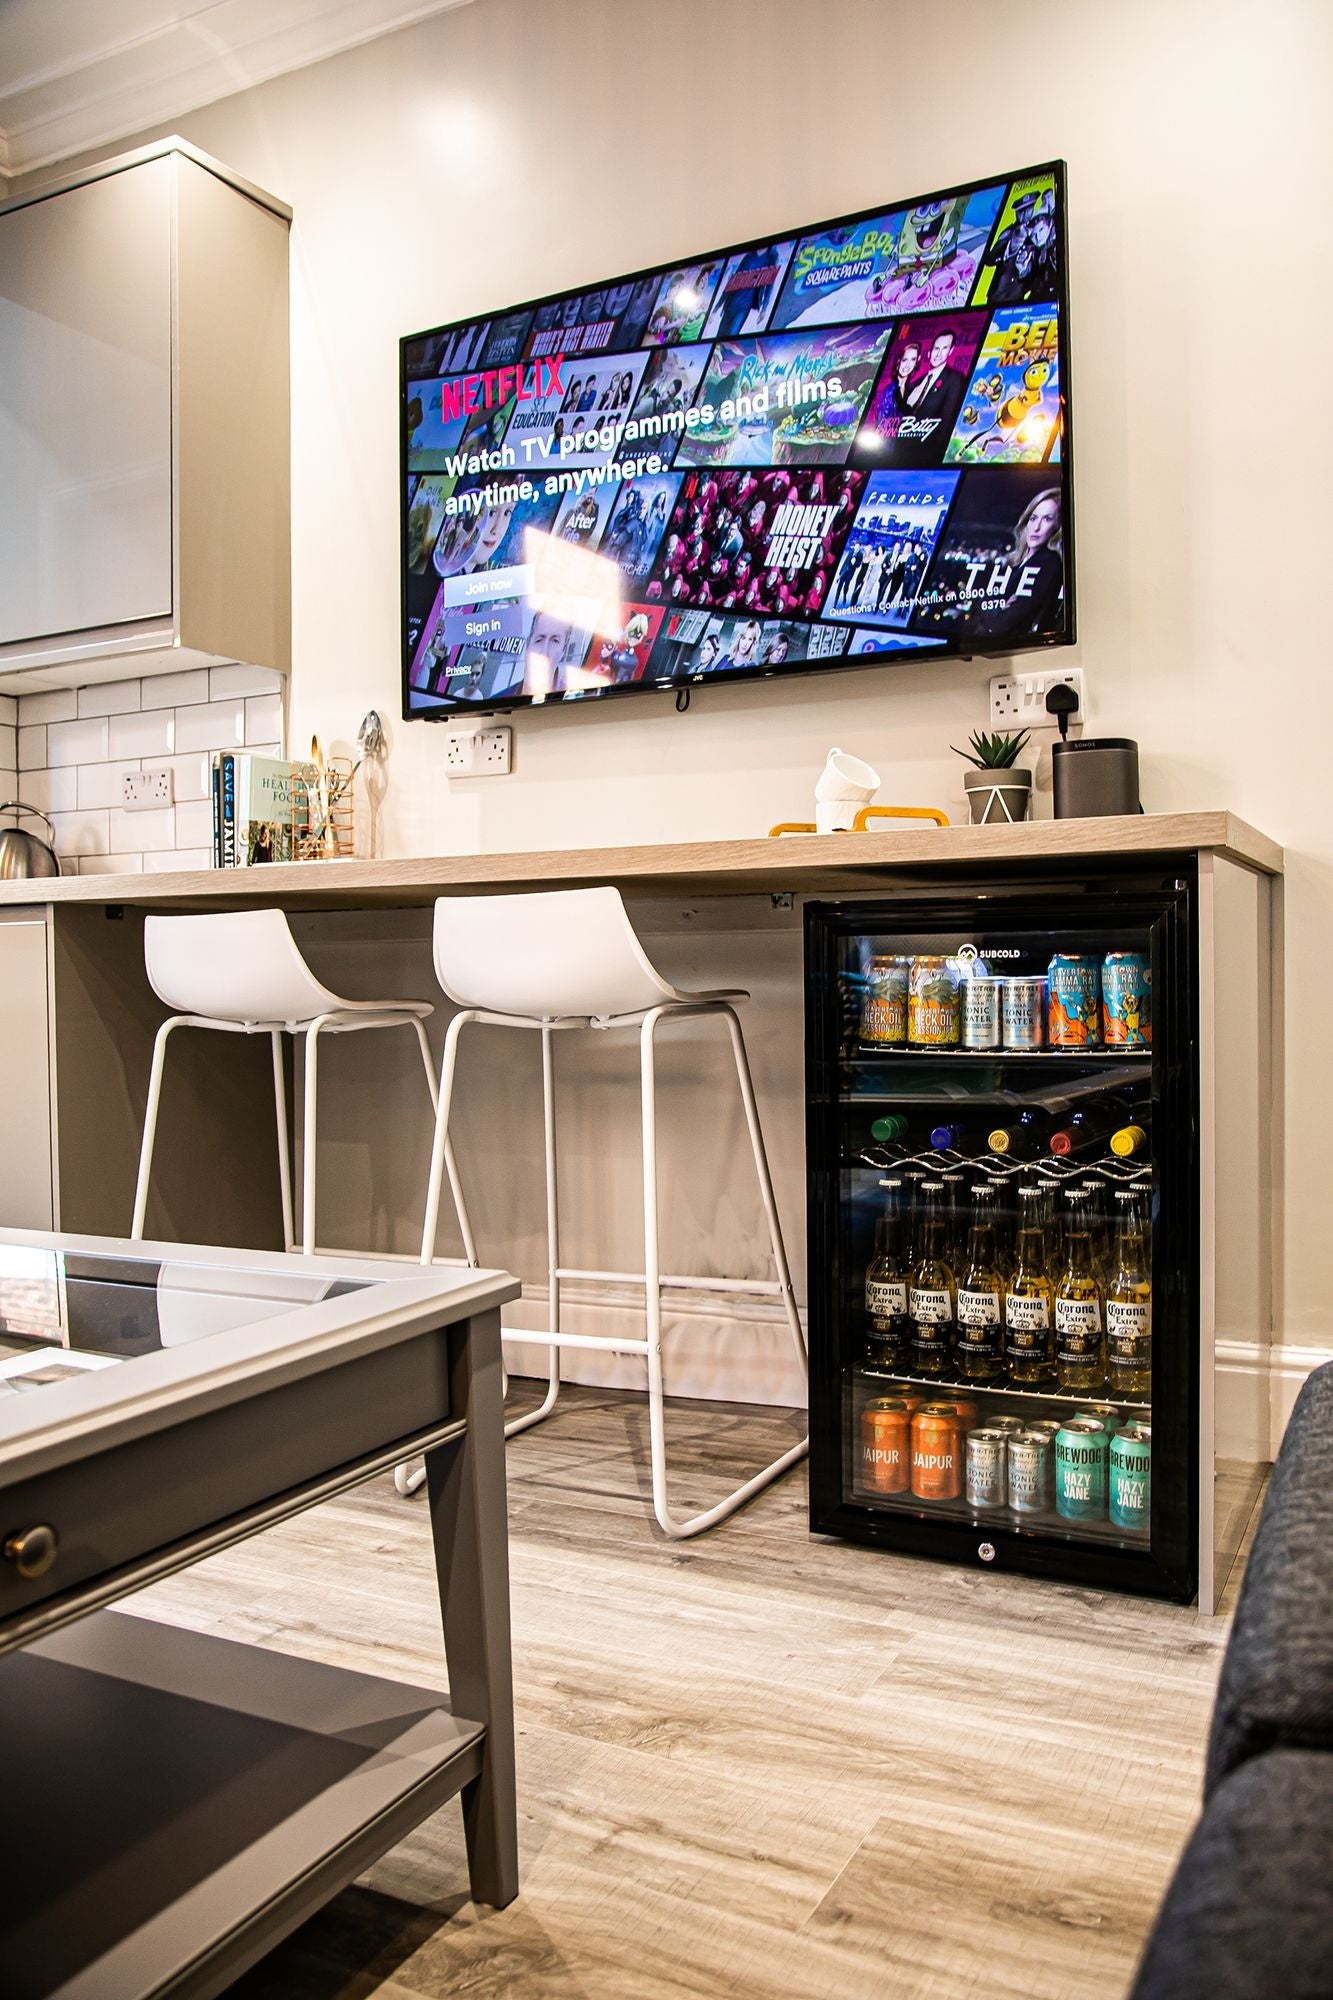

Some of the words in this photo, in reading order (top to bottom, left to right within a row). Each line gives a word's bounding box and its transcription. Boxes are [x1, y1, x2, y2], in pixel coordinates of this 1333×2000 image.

[805, 260, 873, 286] SQUAREPANTS
[441, 352, 565, 424] NETFLIX
[444, 443, 516, 479] Watch
[520, 433, 555, 462] TV
[559, 403, 715, 461] programmes
[720, 386, 769, 419] and
[776, 376, 843, 409] films
[511, 410, 557, 429] EDUCATION
[898, 416, 942, 442] Betty
[444, 480, 540, 516] anytime,
[544, 454, 669, 496] anywhere.
[565, 512, 596, 529] After
[769, 504, 840, 538] MONEY
[764, 536, 823, 570] HEIST
[465, 581, 488, 596] Join
[490, 579, 513, 591] now
[963, 562, 1041, 597] THE
[829, 602, 876, 617] Questions?
[914, 592, 943, 606] Netflix
[946, 592, 957, 601] on
[959, 588, 985, 600] 0800
[465, 622, 489, 637] Sign
[445, 664, 472, 677] Privacy
[692, 673, 704, 682] JVC
[223, 762, 233, 802] SAVE
[979, 949, 1021, 959] SUBCOLD
[864, 1011, 887, 1024] NECK
[889, 1012, 902, 1025] OIL
[914, 1012, 938, 1026] NECK
[940, 1013, 954, 1026] OIL
[1005, 1008, 1033, 1017] TONIC
[866, 1281, 902, 1297] Corona
[910, 1289, 946, 1305] Corona
[872, 1295, 893, 1305] Extra
[916, 1303, 937, 1312] Extra
[958, 1292, 995, 1307] Corona
[1007, 1296, 1044, 1312] Corona
[1057, 1301, 1096, 1315] Corona
[965, 1305, 986, 1315] Extra
[1013, 1309, 1035, 1319] Extra
[1065, 1314, 1087, 1323] Extra
[1107, 1303, 1147, 1318] Corona
[1115, 1316, 1138, 1326] Extra
[863, 1446, 899, 1464] JAIPUR
[913, 1451, 953, 1470] JAIPUR
[1056, 1443, 1102, 1465] BREWDOG
[1110, 1448, 1150, 1473] BREWDO
[1063, 1470, 1091, 1487] HAZY
[1117, 1477, 1145, 1495] HAZY
[1063, 1484, 1090, 1501] JANE
[1116, 1492, 1144, 1509] JANE
